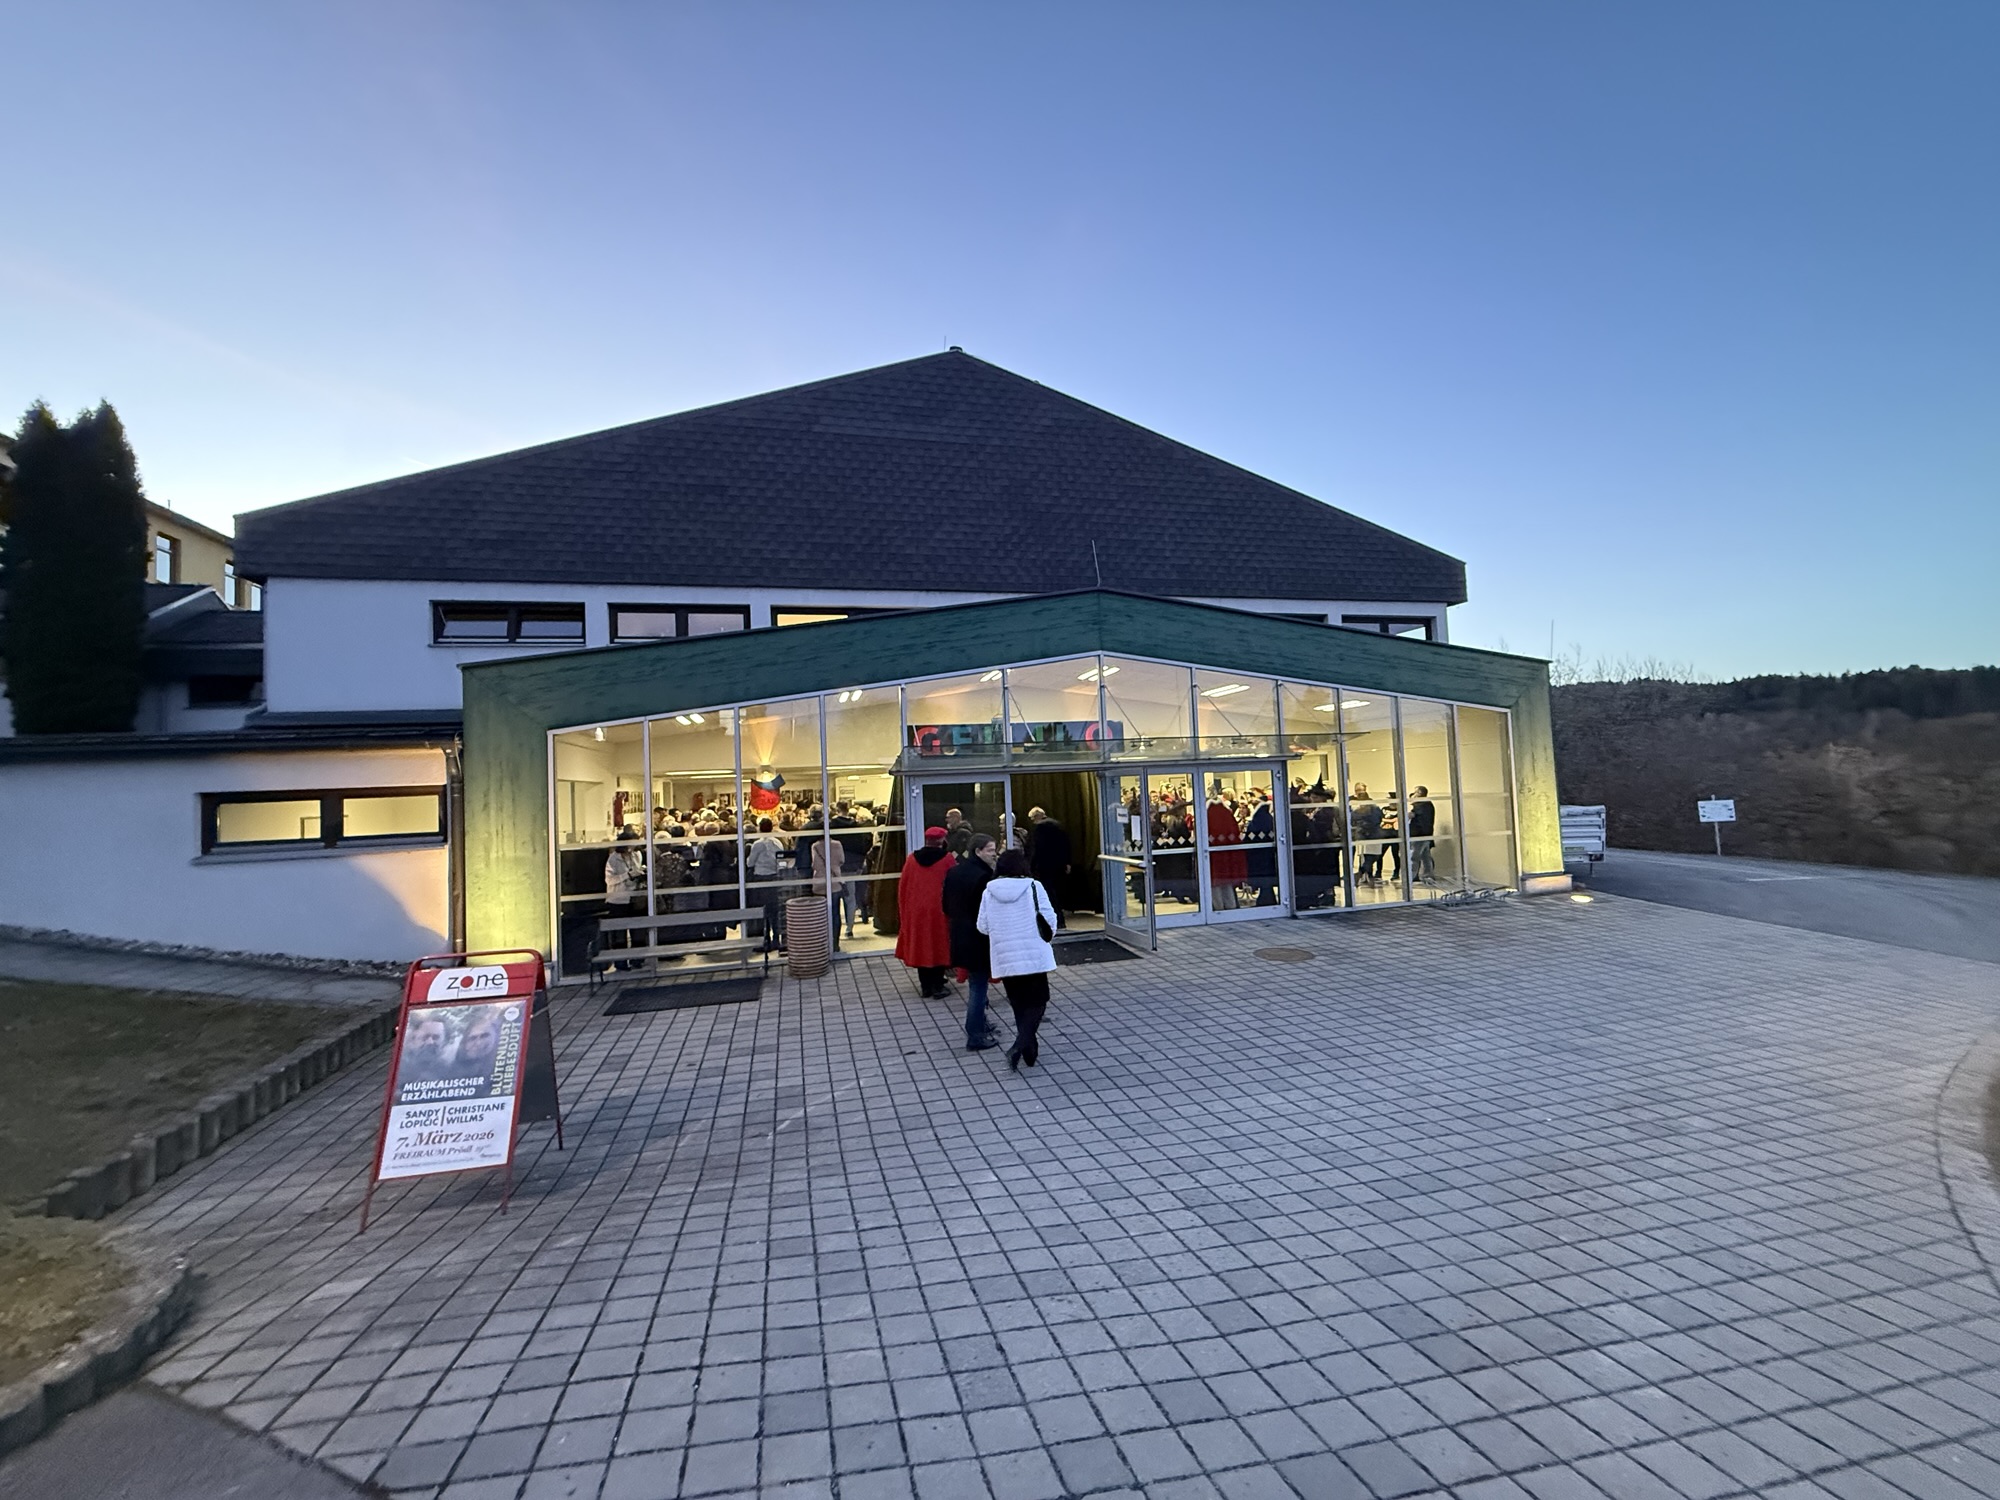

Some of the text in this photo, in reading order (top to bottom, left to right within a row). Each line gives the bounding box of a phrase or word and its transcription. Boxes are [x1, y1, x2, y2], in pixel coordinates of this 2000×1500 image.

[446, 973, 505, 990] zone
[490, 1022, 511, 1095] BLÜTENLUST
[402, 1076, 485, 1092] MUSIKALISCHER
[400, 1087, 476, 1102] ERZÄHLABEND
[405, 1108, 440, 1119] SANDY
[447, 1102, 506, 1115] CHRISTIANE
[446, 1114, 485, 1125] WILLMS
[395, 1129, 495, 1151] 7. März 2026
